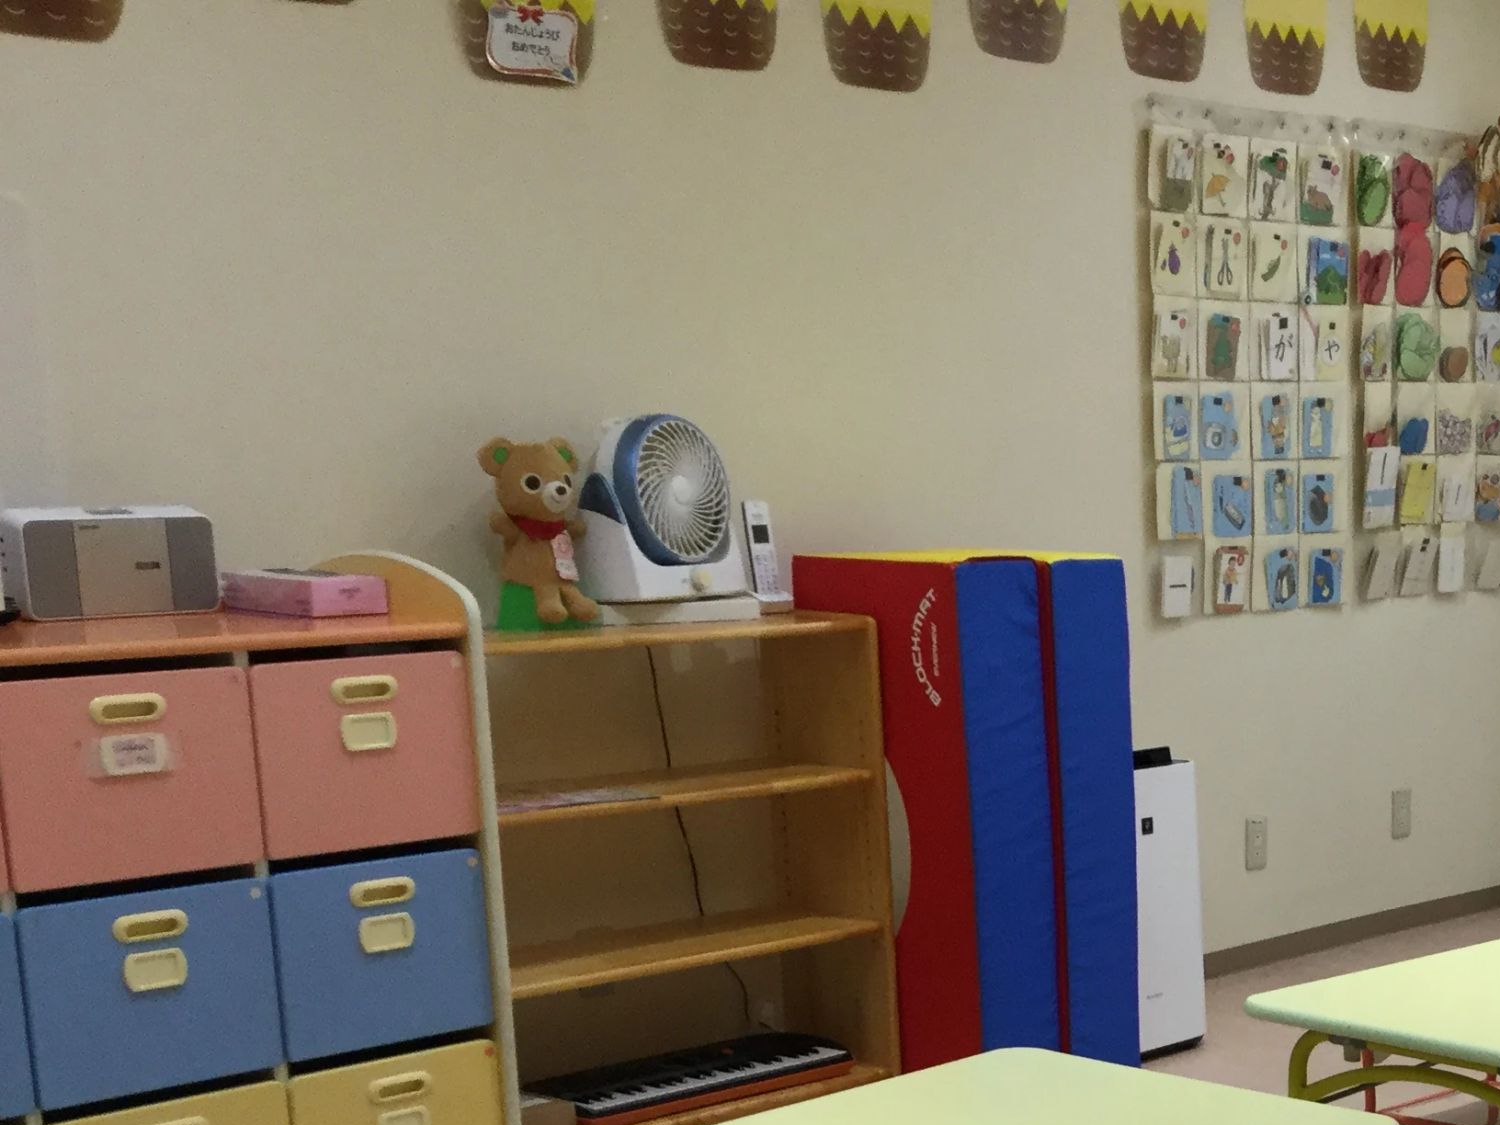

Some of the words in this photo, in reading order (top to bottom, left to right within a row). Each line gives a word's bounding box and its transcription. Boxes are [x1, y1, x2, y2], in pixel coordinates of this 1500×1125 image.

[511, 41, 552, 57] おめでとう
[1274, 333, 1294, 363] が
[1324, 339, 1341, 361] や
